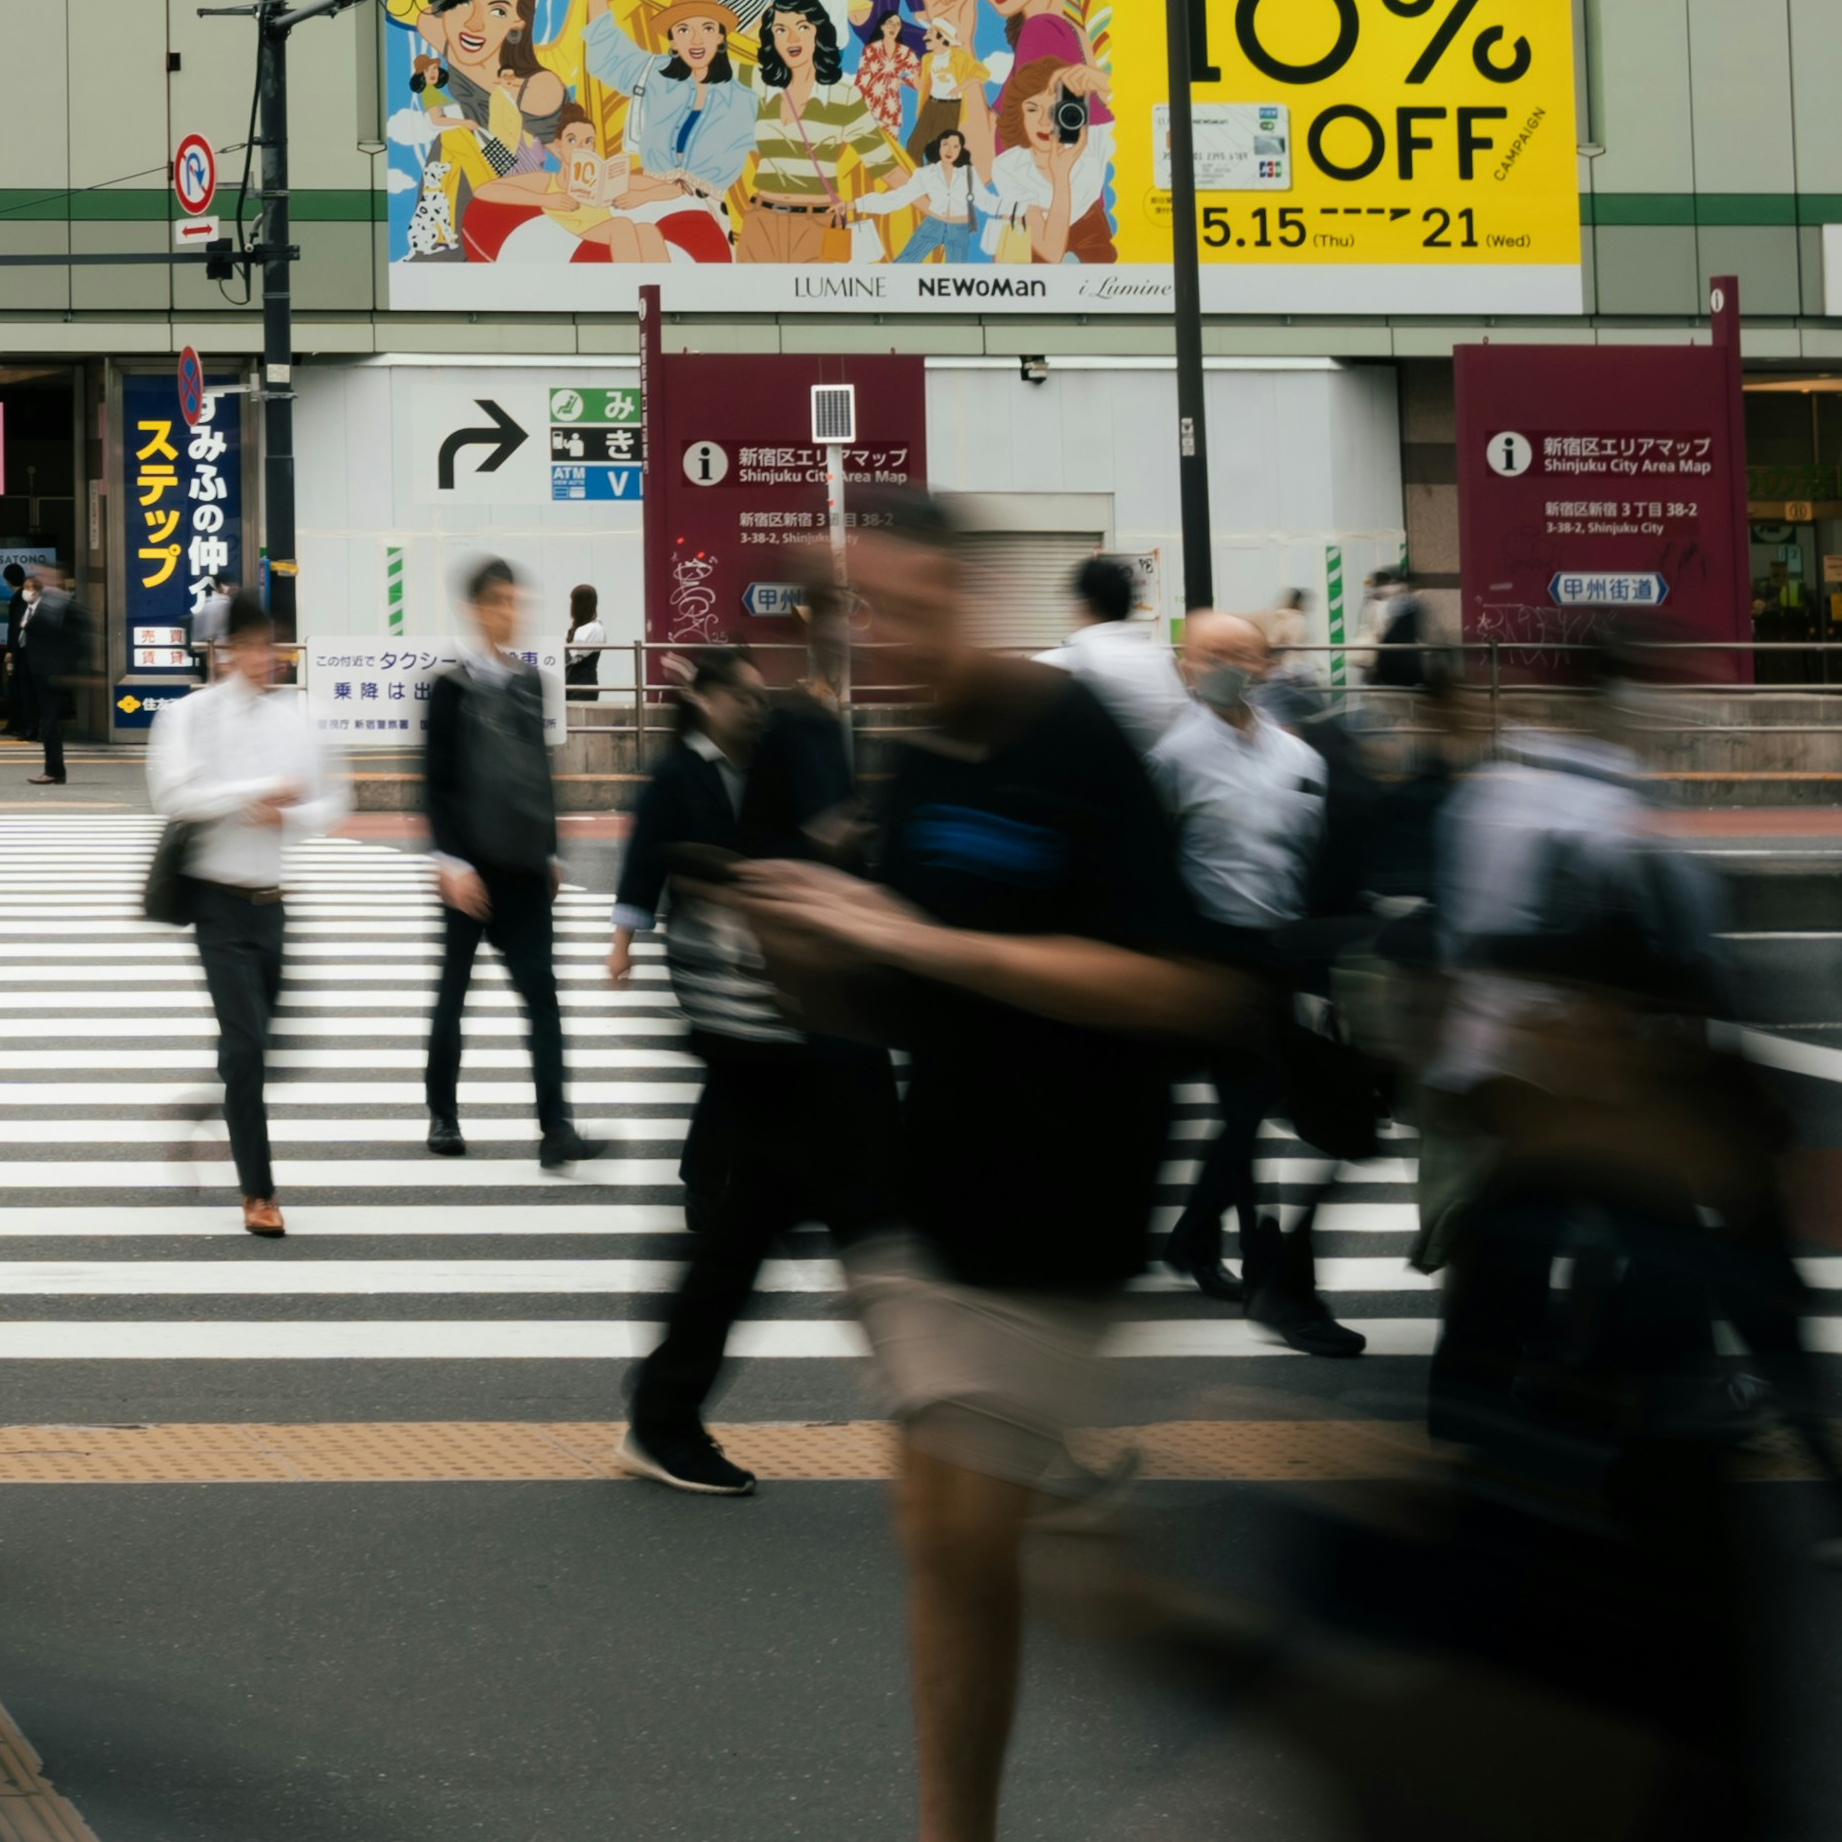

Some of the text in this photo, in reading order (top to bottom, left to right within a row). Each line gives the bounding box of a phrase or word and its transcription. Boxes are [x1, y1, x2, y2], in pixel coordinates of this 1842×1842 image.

[1307, 103, 1508, 181] OFF
[1492, 104, 1547, 183] CAMPAIGN
[1202, 207, 1532, 249] 5.15 (Thu) 21 (Wed)
[794, 276, 1173, 300] LUMINE NEWoMan i Lumine
[1543, 437, 1712, 457] 新宿区エリアマップ
[553, 467, 586, 480] ATM
[1544, 459, 1712, 475] Shinjuku City Area Map
[739, 468, 802, 485] Shinjuku
[875, 470, 908, 485] Map
[135, 420, 182, 589] ステップ
[1545, 502, 1617, 518] 新宿区新宿
[739, 511, 813, 528] 新宿区新宿
[1587, 521, 1638, 536] Shinjuku
[1640, 521, 1665, 536] City
[1563, 577, 1653, 601] 甲州街道
[316, 655, 376, 669] この付近で
